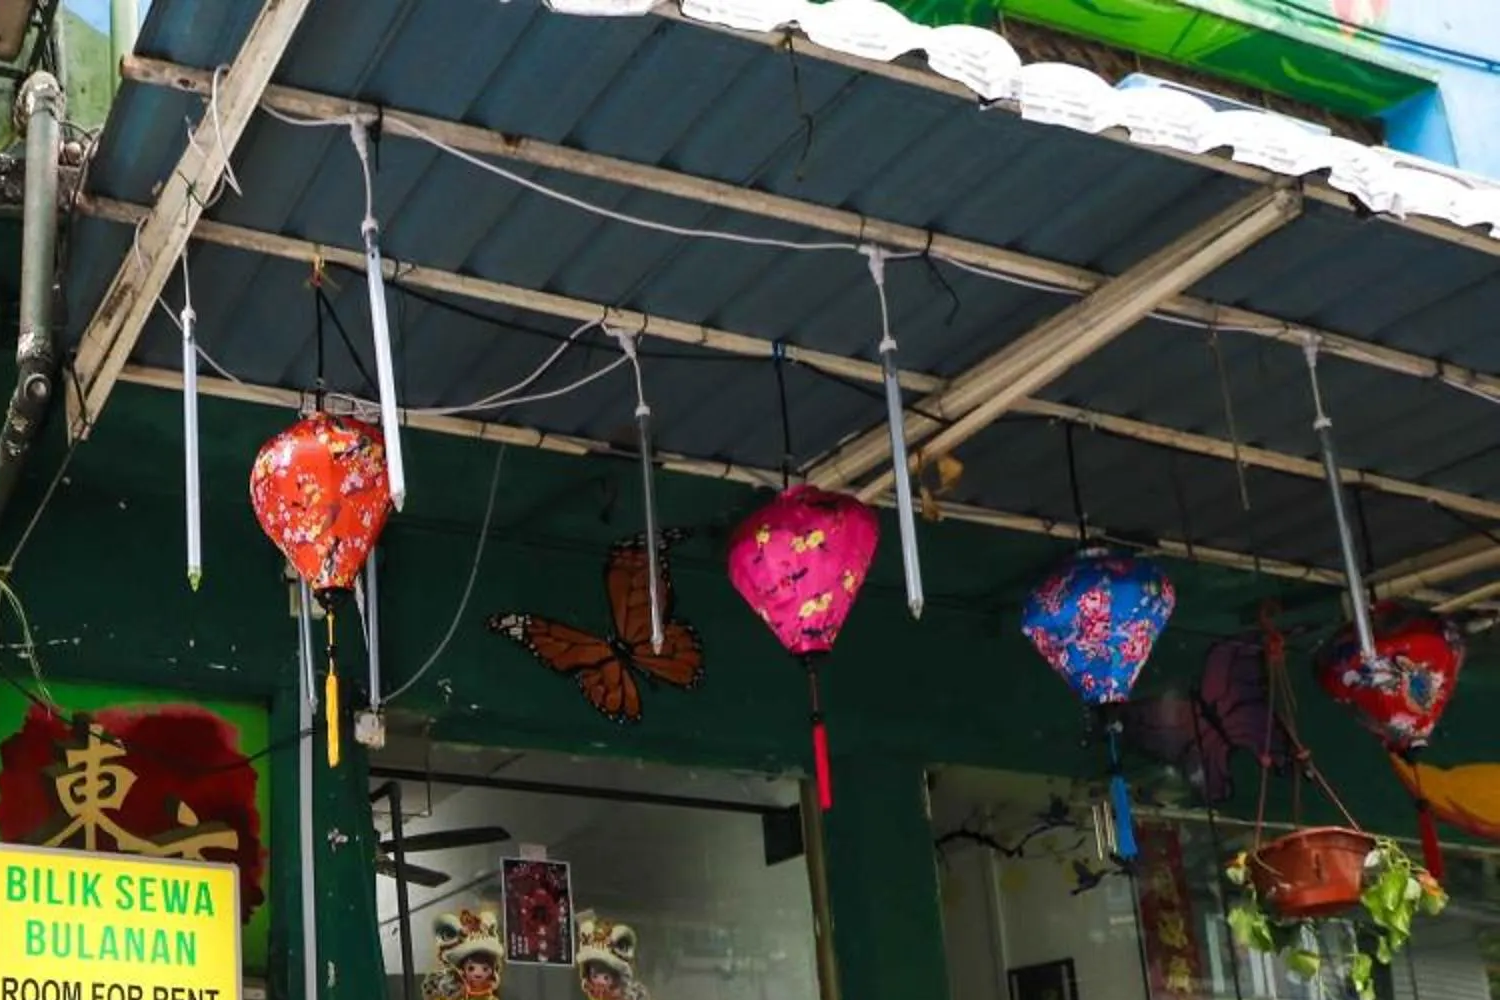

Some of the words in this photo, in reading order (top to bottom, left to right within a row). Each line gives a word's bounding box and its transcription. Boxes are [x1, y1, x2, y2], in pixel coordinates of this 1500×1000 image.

[6, 865, 103, 909] BILIK
[115, 874, 215, 918] SEWA
[25, 919, 197, 967] BULANAN
